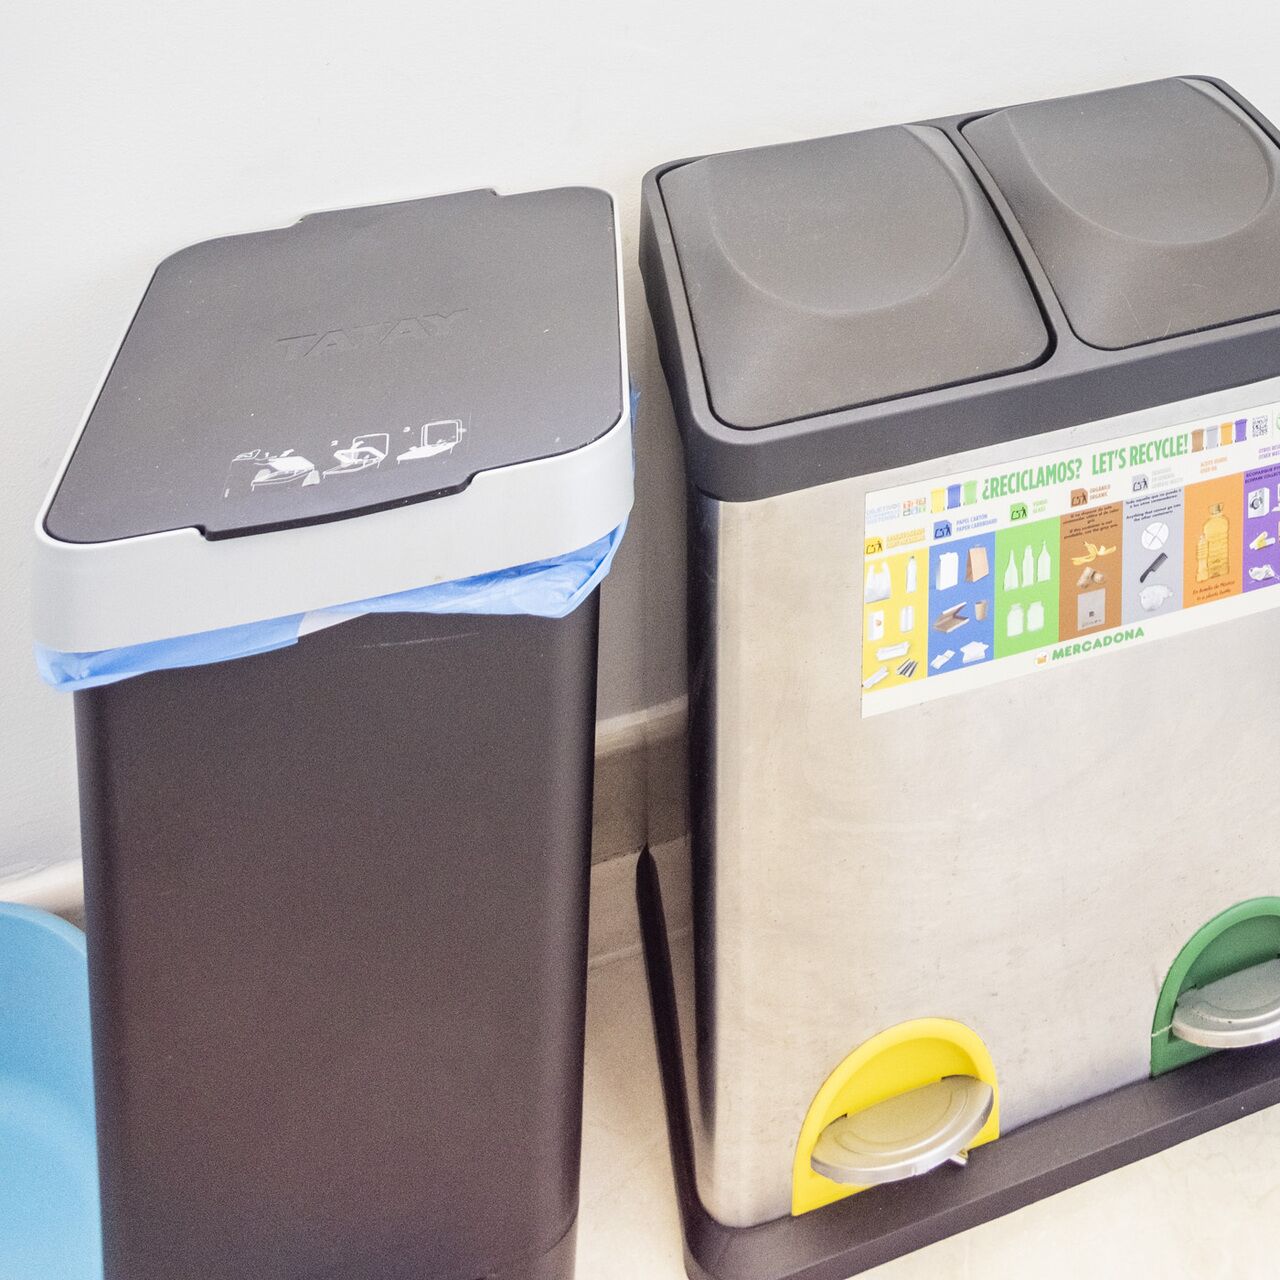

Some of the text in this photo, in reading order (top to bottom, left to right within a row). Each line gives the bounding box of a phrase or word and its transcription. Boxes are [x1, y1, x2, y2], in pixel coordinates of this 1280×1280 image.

[982, 458, 1082, 500] ¿RECICLAMOS?
[1092, 448, 1127, 475] LET'S
[1130, 433, 1189, 470] RECYCLE!
[1051, 627, 1145, 661] MERCADONA
